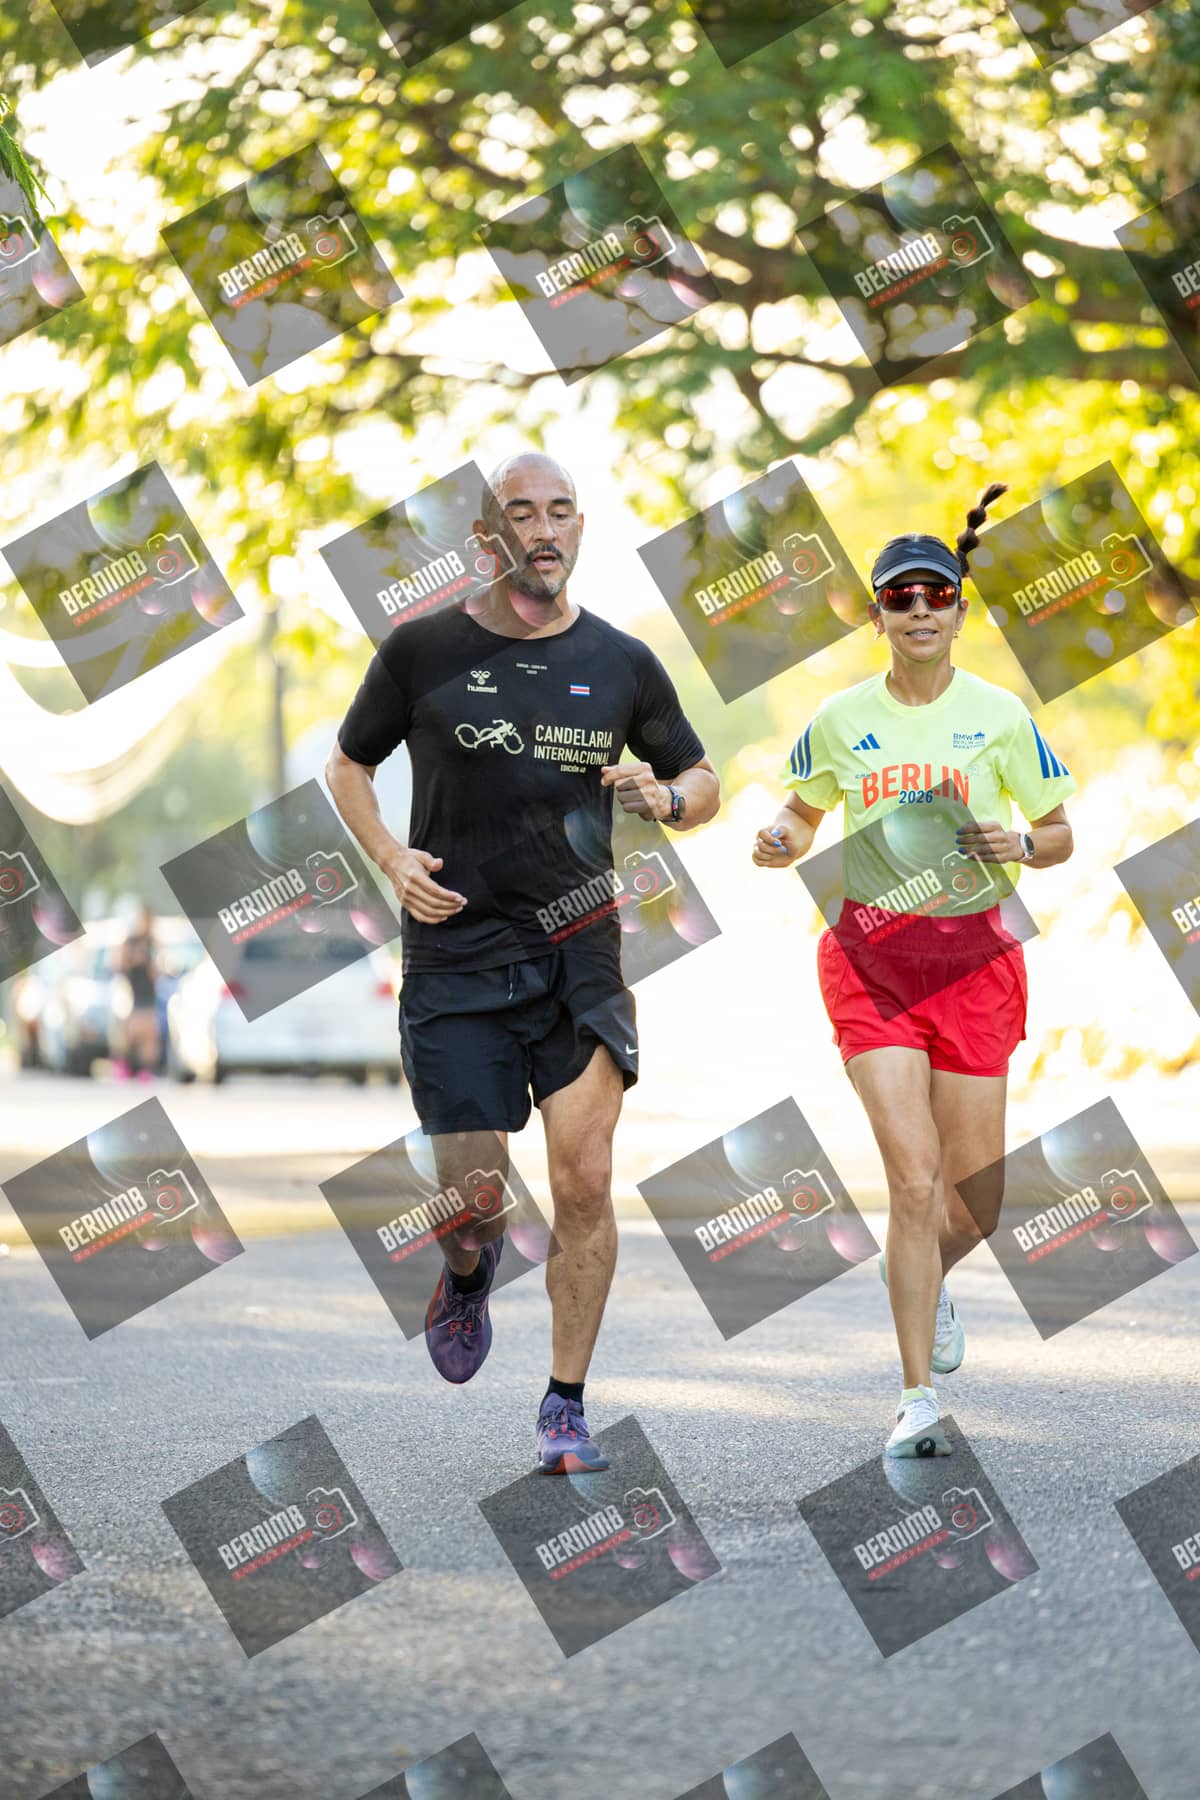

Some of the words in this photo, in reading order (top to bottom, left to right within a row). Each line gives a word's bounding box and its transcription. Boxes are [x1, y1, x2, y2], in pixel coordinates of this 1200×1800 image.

[535, 724, 613, 748] CANDELARIA
[953, 732, 973, 740] BMW
[533, 744, 609, 766] INTERNACIONAL
[862, 763, 969, 809] BERLIN
[898, 790, 934, 804] 2026
